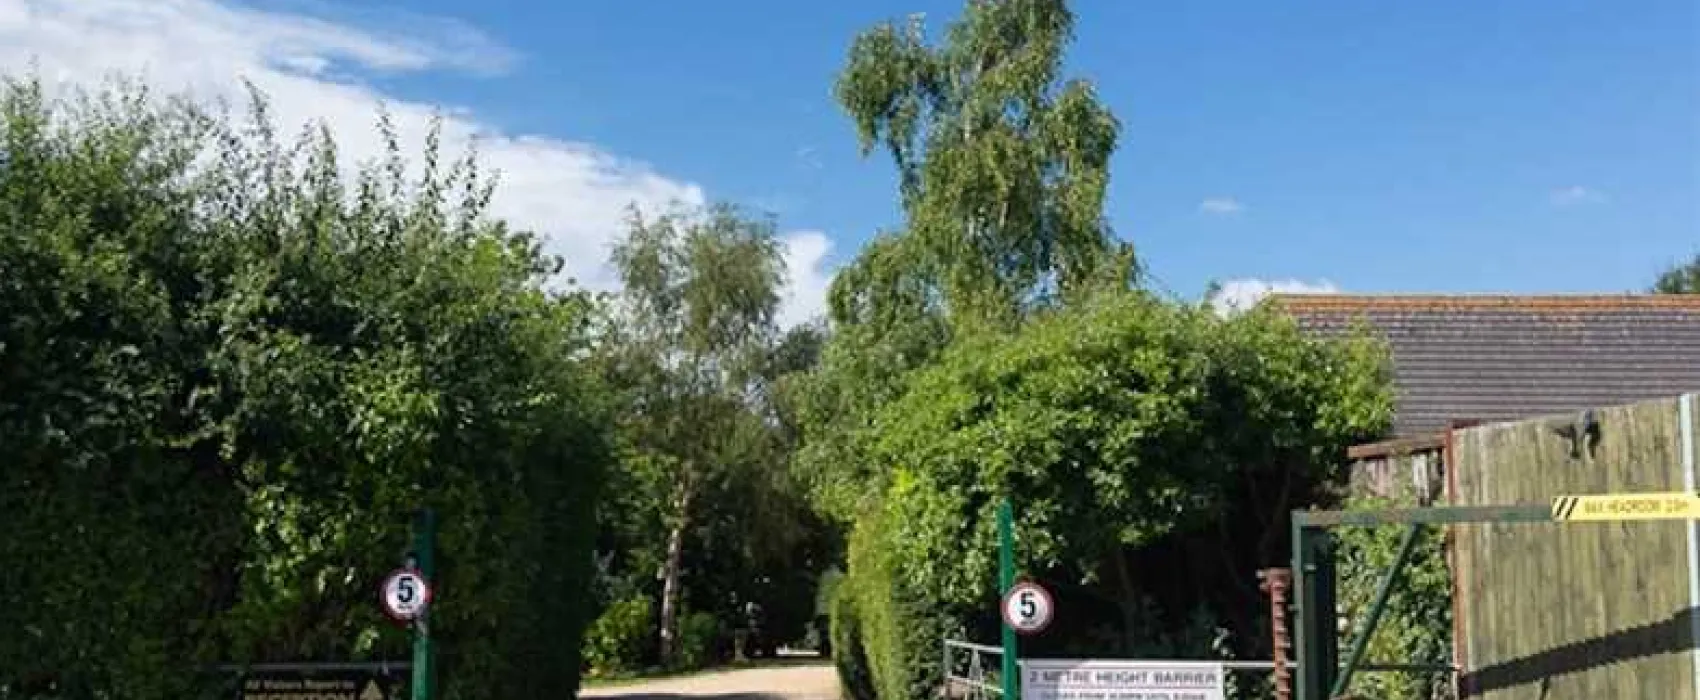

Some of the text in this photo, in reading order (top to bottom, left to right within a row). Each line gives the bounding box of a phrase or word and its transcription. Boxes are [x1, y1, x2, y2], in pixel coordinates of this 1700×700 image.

[398, 576, 413, 603] 5
[1020, 591, 1035, 618] 5
[1042, 671, 1091, 683] METRE
[1097, 671, 1148, 683] HEIGHT
[1155, 671, 1216, 683] BARRIER
